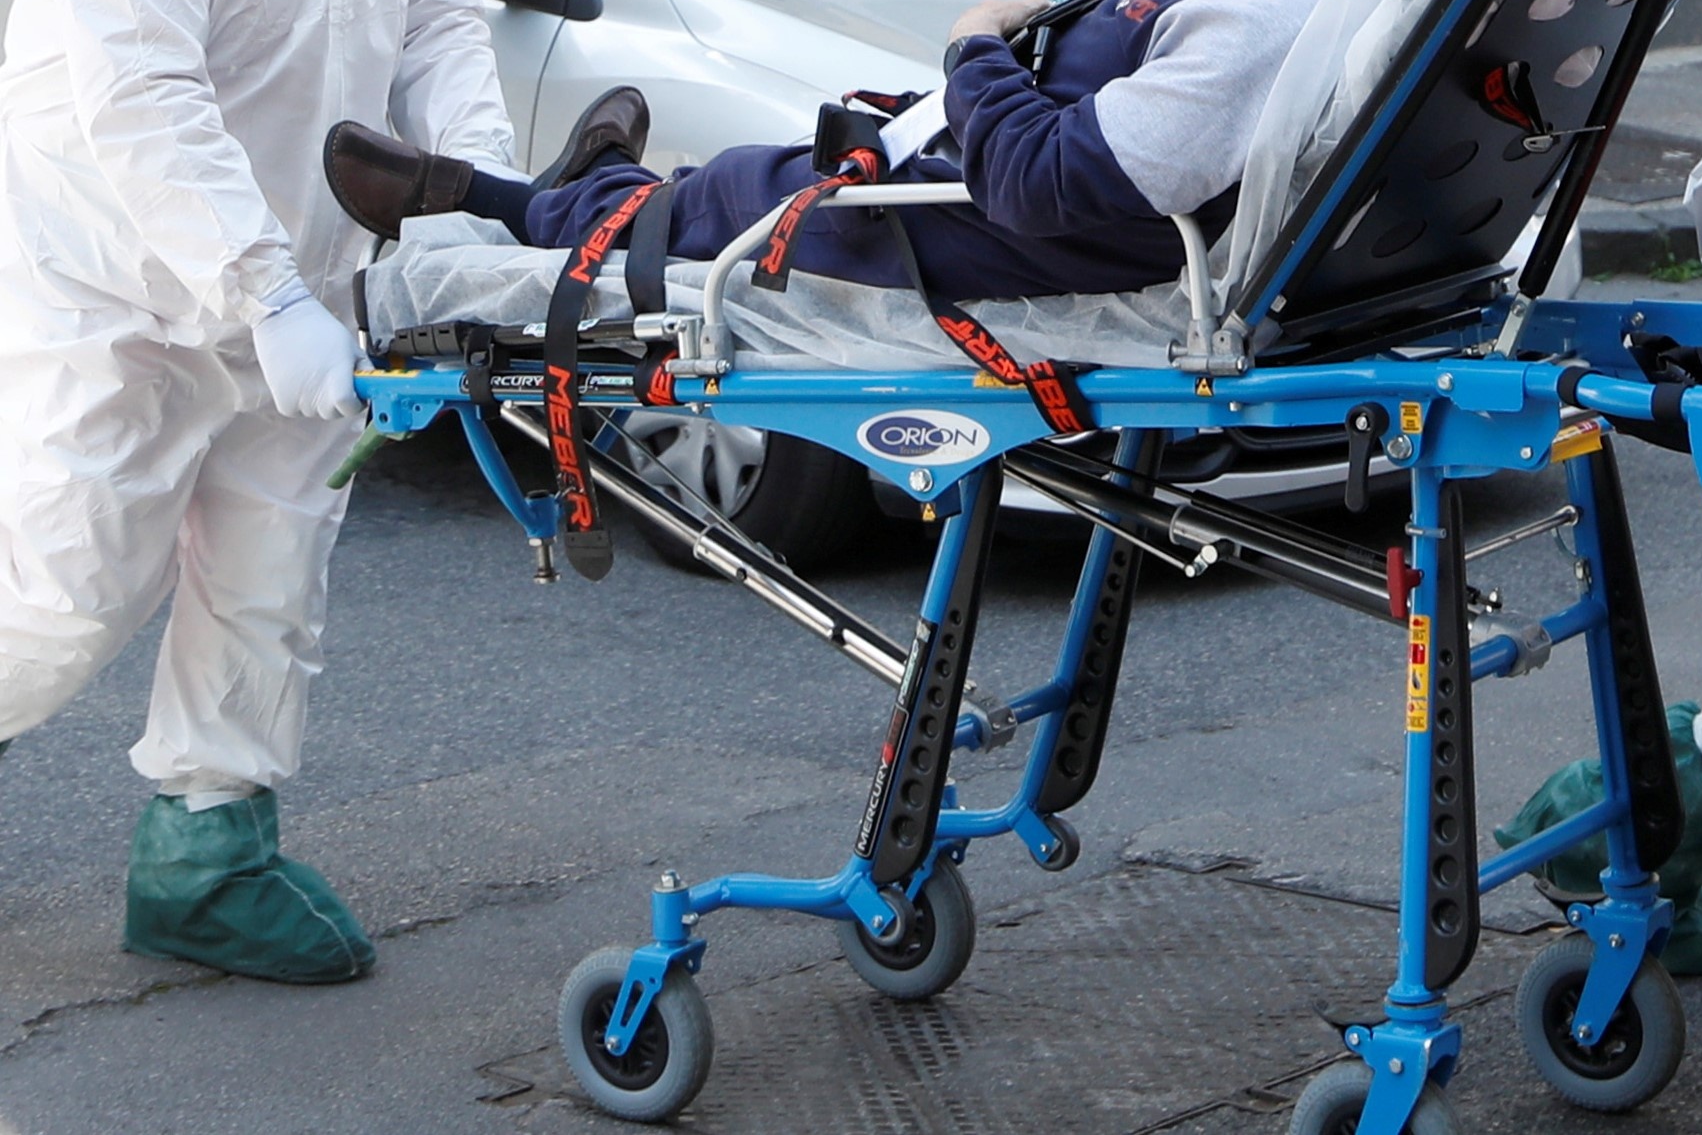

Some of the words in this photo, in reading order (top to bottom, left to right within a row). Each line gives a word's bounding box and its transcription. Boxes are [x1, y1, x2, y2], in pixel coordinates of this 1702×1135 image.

[568, 181, 661, 284] MEBER
[880, 426, 978, 447] ORION
[857, 757, 889, 852] MERCURY
